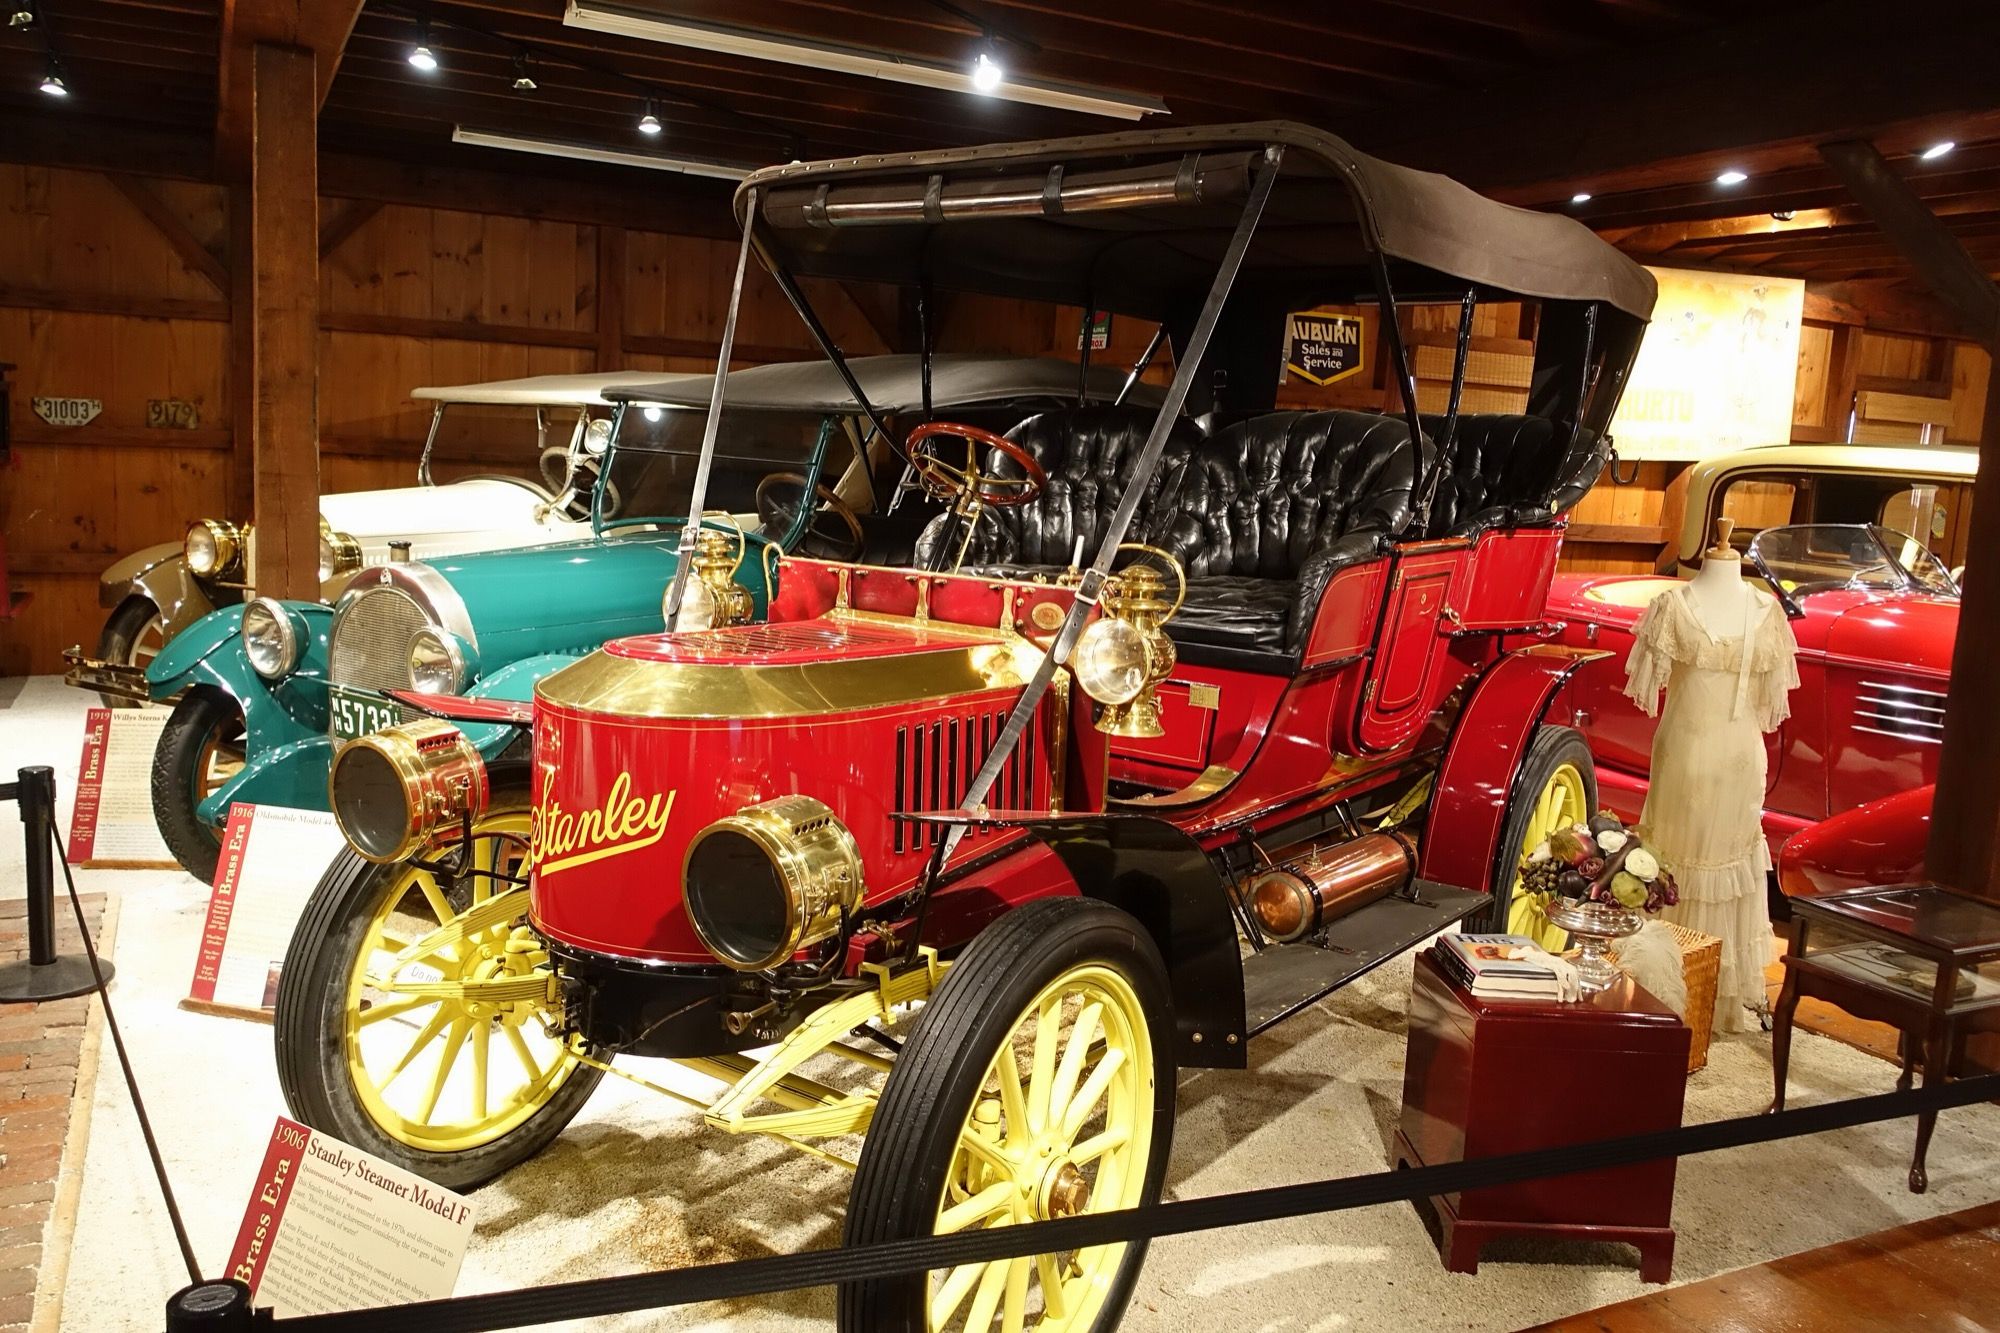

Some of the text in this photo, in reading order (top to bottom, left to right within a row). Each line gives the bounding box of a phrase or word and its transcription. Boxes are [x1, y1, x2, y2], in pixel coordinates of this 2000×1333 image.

[1301, 343, 1344, 358] Sales and
[1303, 355, 1342, 369] Service
[44, 400, 89, 420] 31003
[151, 403, 193, 422] 9179
[90, 712, 110, 720] 1919
[113, 713, 137, 723] Willys
[89, 725, 103, 746] Era
[84, 748, 100, 779] Brass
[232, 806, 254, 818] 1916
[256, 811, 297, 822] Oldsmobile
[299, 815, 322, 825] Model
[531, 771, 677, 877] Stanley
[228, 824, 246, 852] Era
[218, 854, 239, 895] Brass
[410, 966, 425, 980] Do
[275, 1123, 308, 1150] 1906
[307, 1137, 471, 1226] Stanley Steamer Model F
[335, 1179, 353, 1195] touring
[354, 1190, 372, 1202] steamer
[234, 1158, 291, 1284] Brass Era
[308, 1181, 324, 1196] Stanley
[325, 1190, 341, 1202] Model
[391, 1222, 405, 1234] 1970s
[407, 1231, 417, 1239] and
[448, 1249, 453, 1257] to
[343, 1213, 373, 1230] achievement
[401, 1240, 410, 1249] the
[431, 1256, 446, 1267] about
[394, 1278, 411, 1289] photo
[411, 1286, 424, 1298] shop
